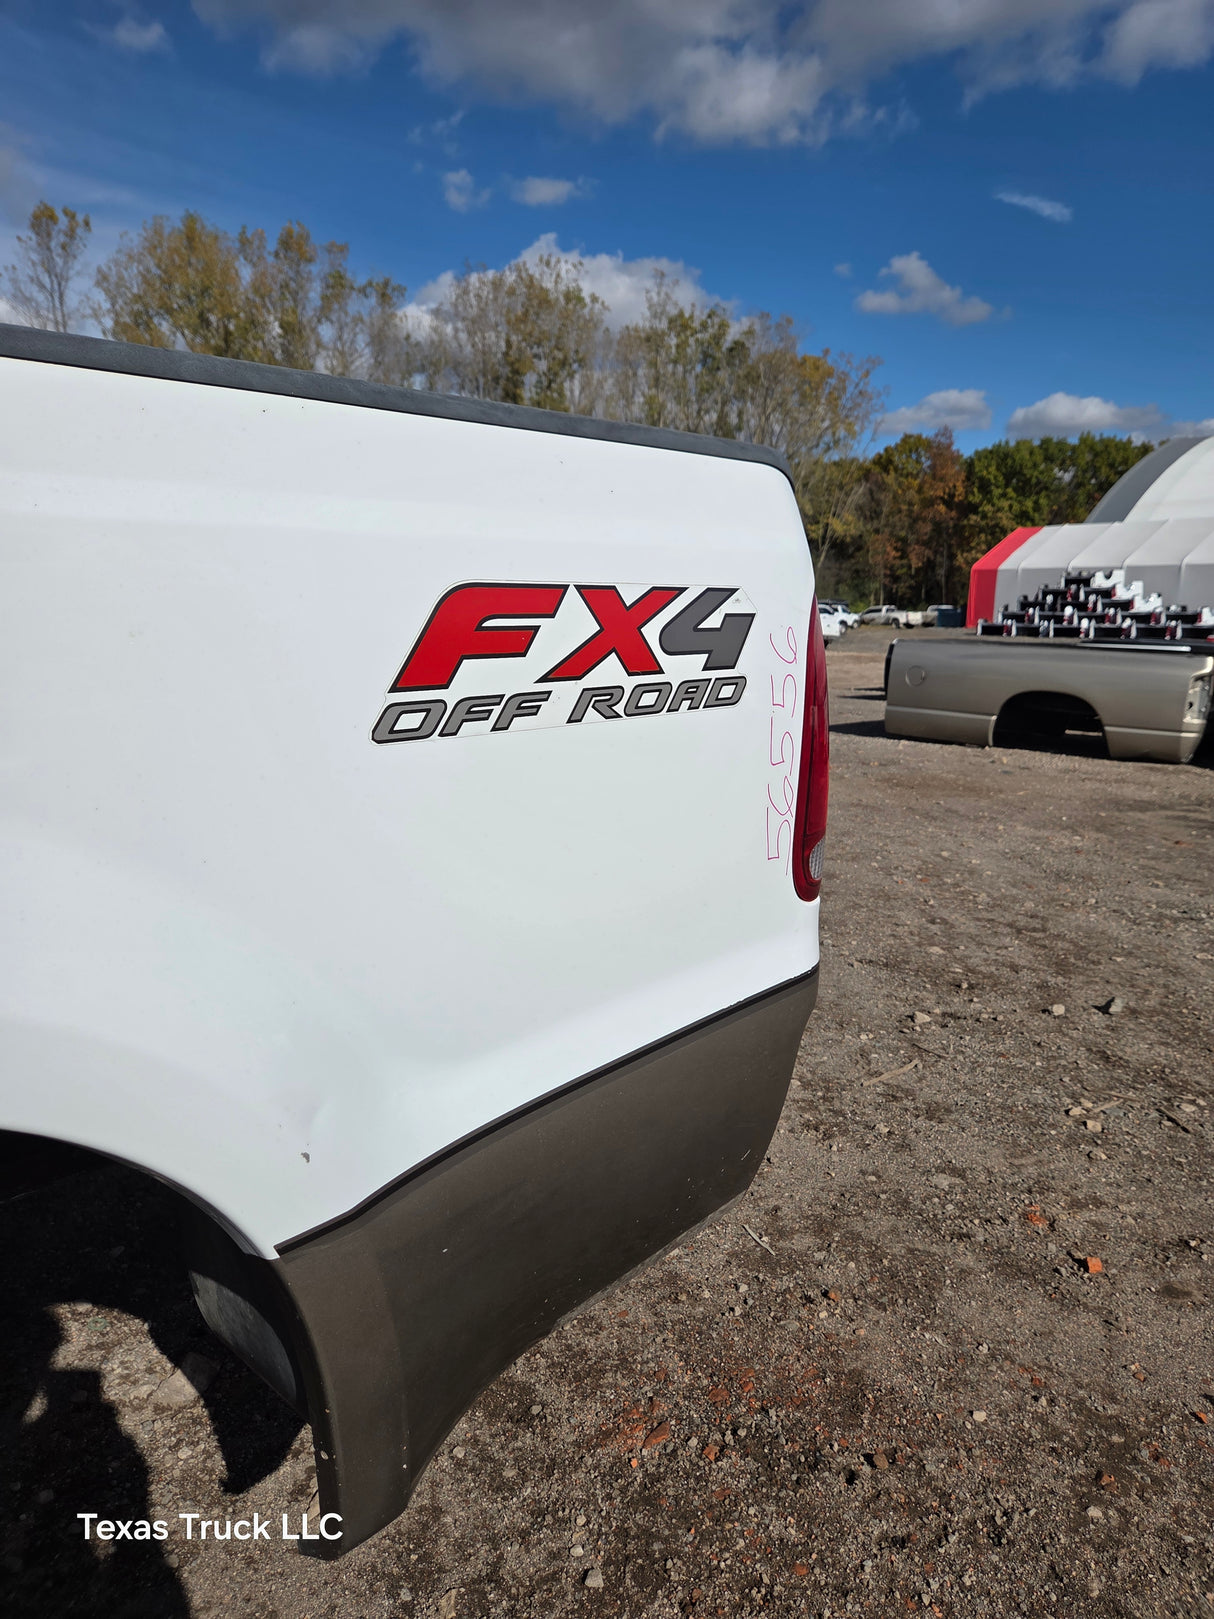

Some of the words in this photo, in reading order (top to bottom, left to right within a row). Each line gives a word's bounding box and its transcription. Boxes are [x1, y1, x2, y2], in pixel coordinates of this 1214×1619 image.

[387, 582, 756, 694] FX4
[371, 690, 553, 744] OFF
[566, 675, 747, 724] ROAD
[766, 626, 798, 876] 56556
